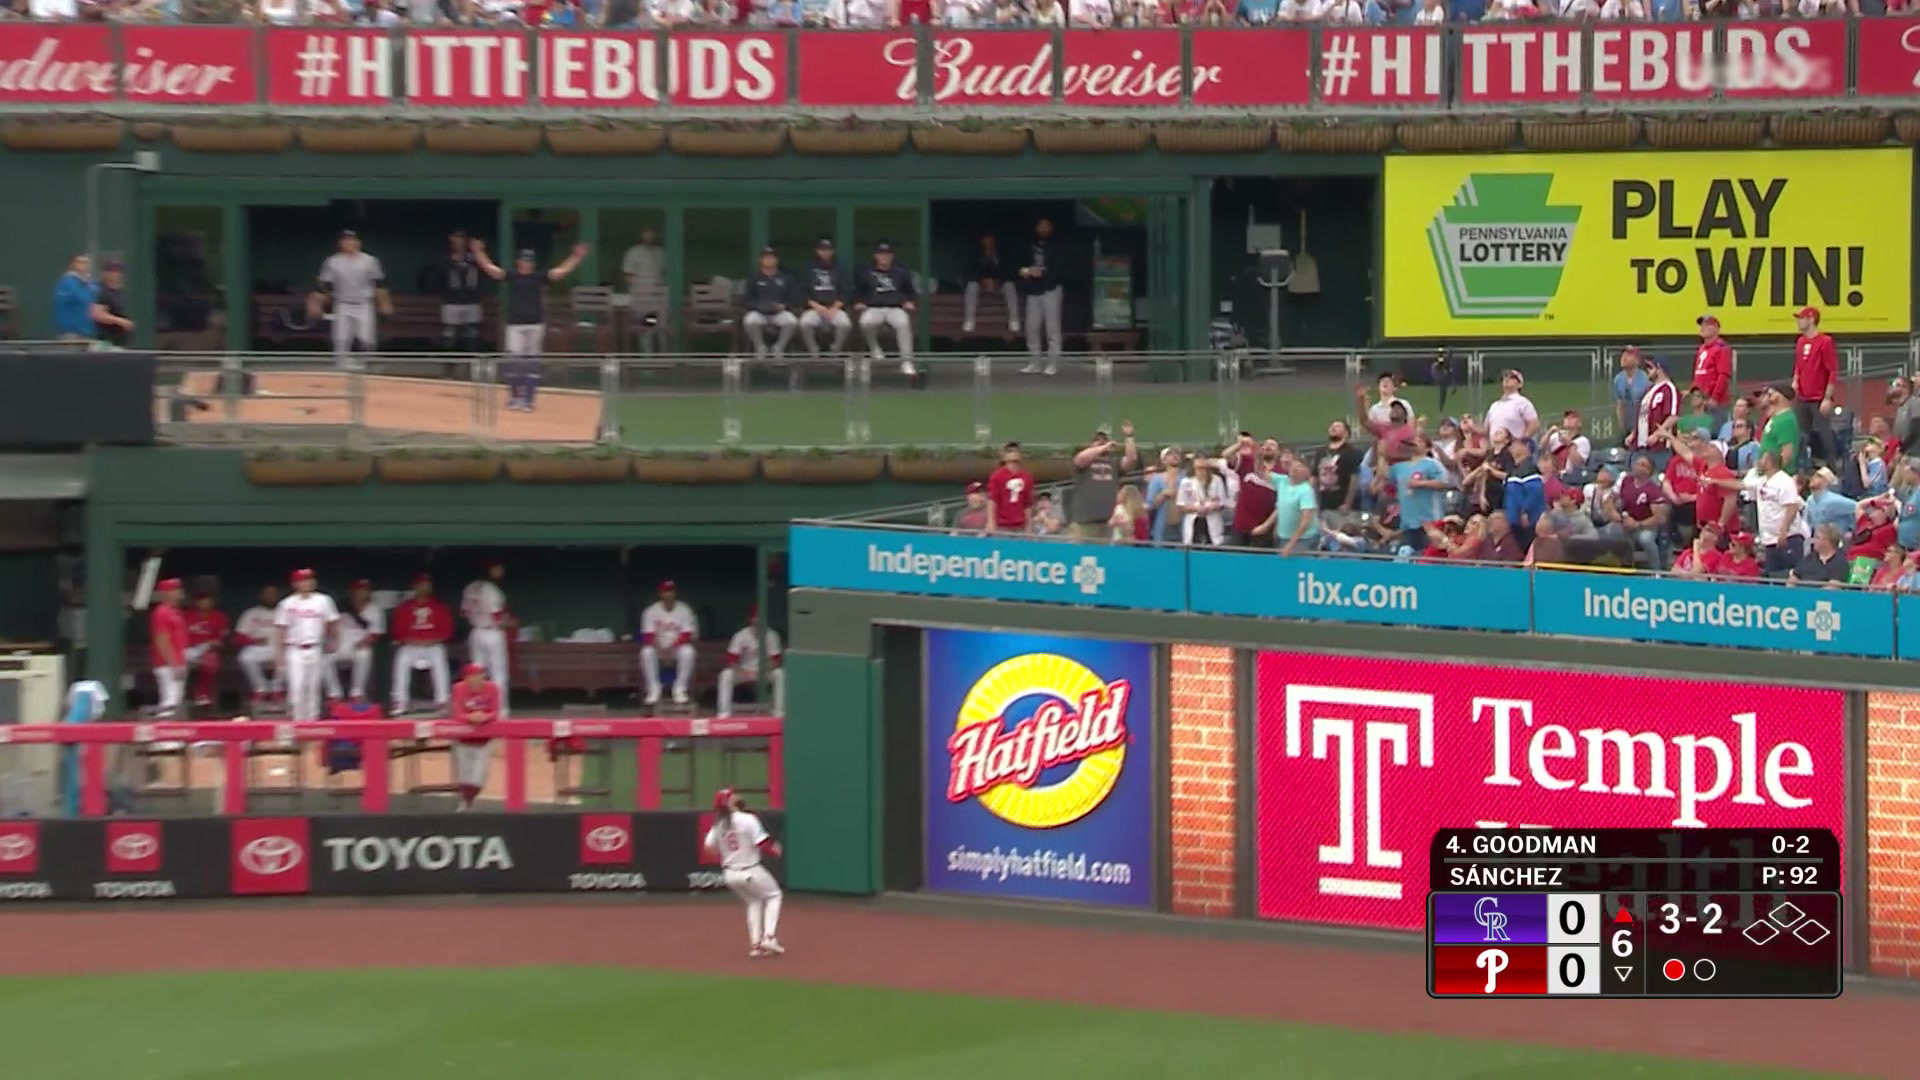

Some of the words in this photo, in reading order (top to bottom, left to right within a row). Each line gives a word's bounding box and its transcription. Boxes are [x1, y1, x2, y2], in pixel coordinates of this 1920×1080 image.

[295, 34, 776, 99] #HITTHEBUDS
[883, 37, 1222, 99] Budweiser
[1306, 27, 1812, 97] #HITTHEBUDS
[1611, 178, 1788, 240] PLAY
[1459, 226, 1567, 241] PENNSYLVANIA
[1459, 243, 1566, 262] LOTTERY
[1630, 258, 1688, 295] TO
[1695, 245, 1865, 307] WIN!
[868, 543, 1067, 586] Independence
[1297, 571, 1418, 611] ibx.com
[1583, 587, 1799, 629] Independence
[950, 681, 1129, 800] Hatfield
[1473, 696, 1814, 828] Temple
[323, 835, 514, 872] TOYOTA
[947, 845, 1132, 886] simplyhatfield.com
[567, 872, 646, 890] TOYOTA
